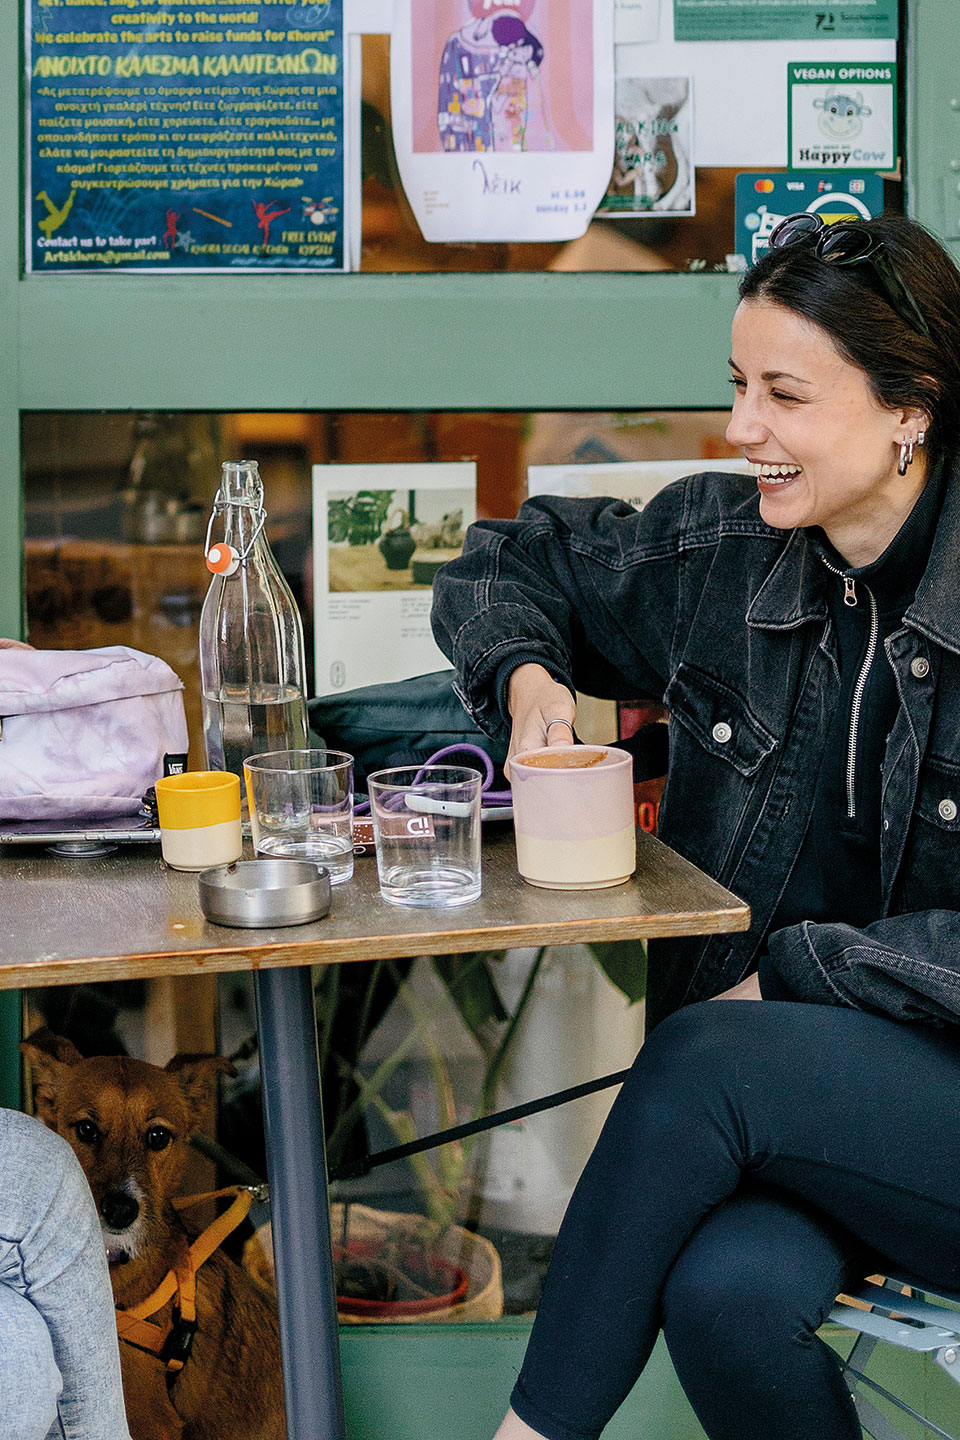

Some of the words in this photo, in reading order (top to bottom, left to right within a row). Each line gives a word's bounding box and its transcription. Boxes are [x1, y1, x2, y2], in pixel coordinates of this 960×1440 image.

[111, 12, 176, 26] creativity
[177, 12, 193, 24] to
[194, 11, 217, 24] the
[55, 31, 118, 44] celebrate
[120, 31, 142, 43] the
[145, 31, 173, 43] arts
[175, 31, 190, 43] to
[191, 30, 223, 43] raise
[225, 29, 262, 42] funds
[264, 29, 286, 42] for
[33, 54, 112, 78] ΑΝΟΙΧΤΟ
[115, 54, 200, 78] ΚΑΛΕΣΜΑ
[793, 68, 835, 80] VEGAN
[838, 68, 892, 80] OPTIONS
[37, 236, 78, 248] Contact
[80, 237, 93, 247] us
[95, 236, 107, 247] to
[109, 235, 131, 247] take
[134, 235, 157, 249] part
